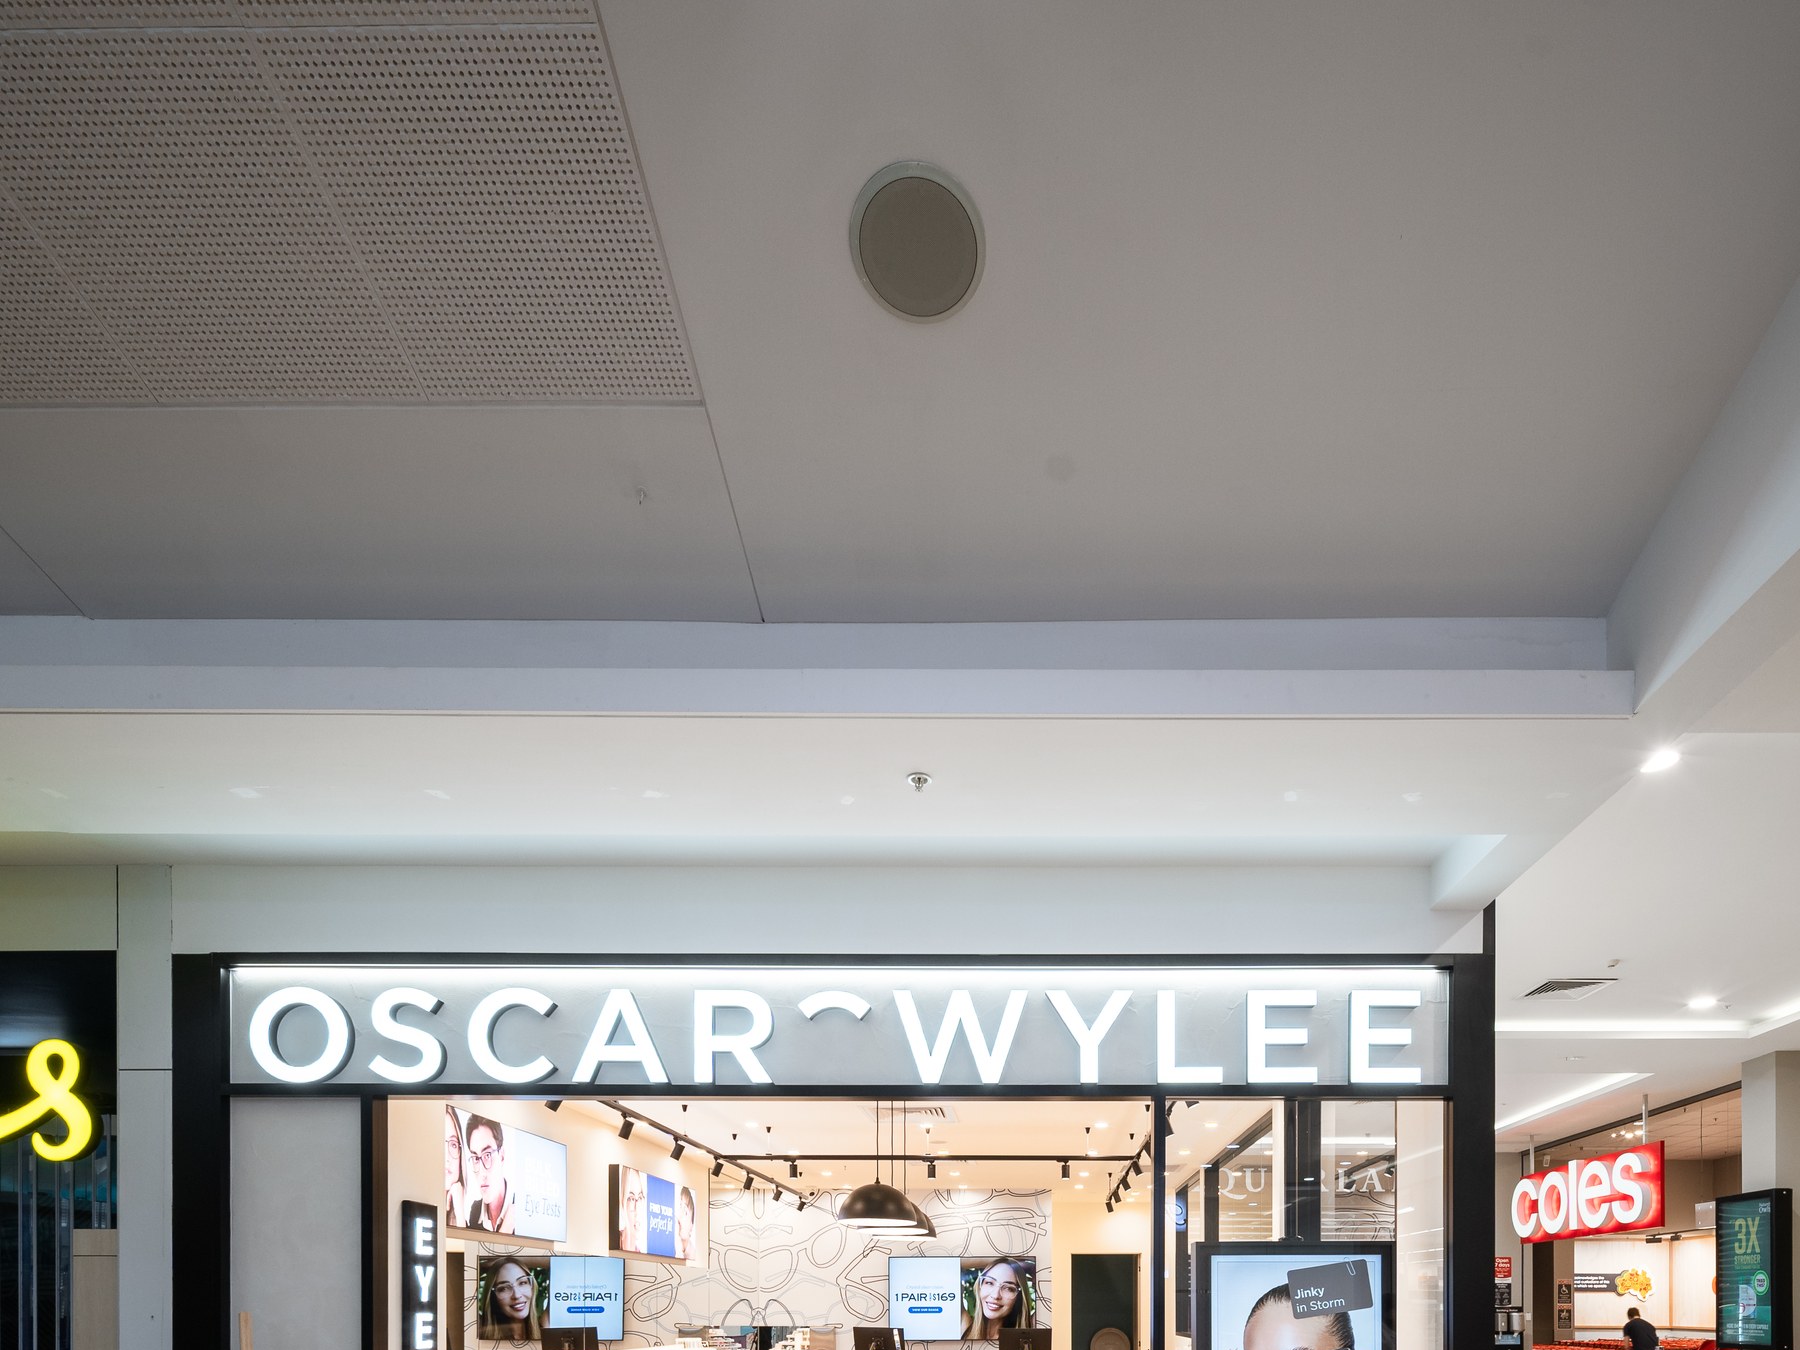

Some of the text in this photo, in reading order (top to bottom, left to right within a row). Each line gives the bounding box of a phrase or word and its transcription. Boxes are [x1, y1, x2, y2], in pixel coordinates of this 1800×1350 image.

[249, 986, 1422, 1084] OSCAR WYLEE
[525, 1194, 561, 1218] Eye Tests
[1511, 1152, 1650, 1238] coles
[1734, 1216, 1761, 1254] 3X
[1734, 1254, 1761, 1265] STRONGER
[414, 1217, 434, 1350] EYE
[1294, 1286, 1325, 1299] Jinky
[895, 1292, 899, 1301] 1
[901, 1292, 928, 1302] PAIR
[932, 1292, 956, 1302] $169
[1296, 1298, 1346, 1313] in Storm
